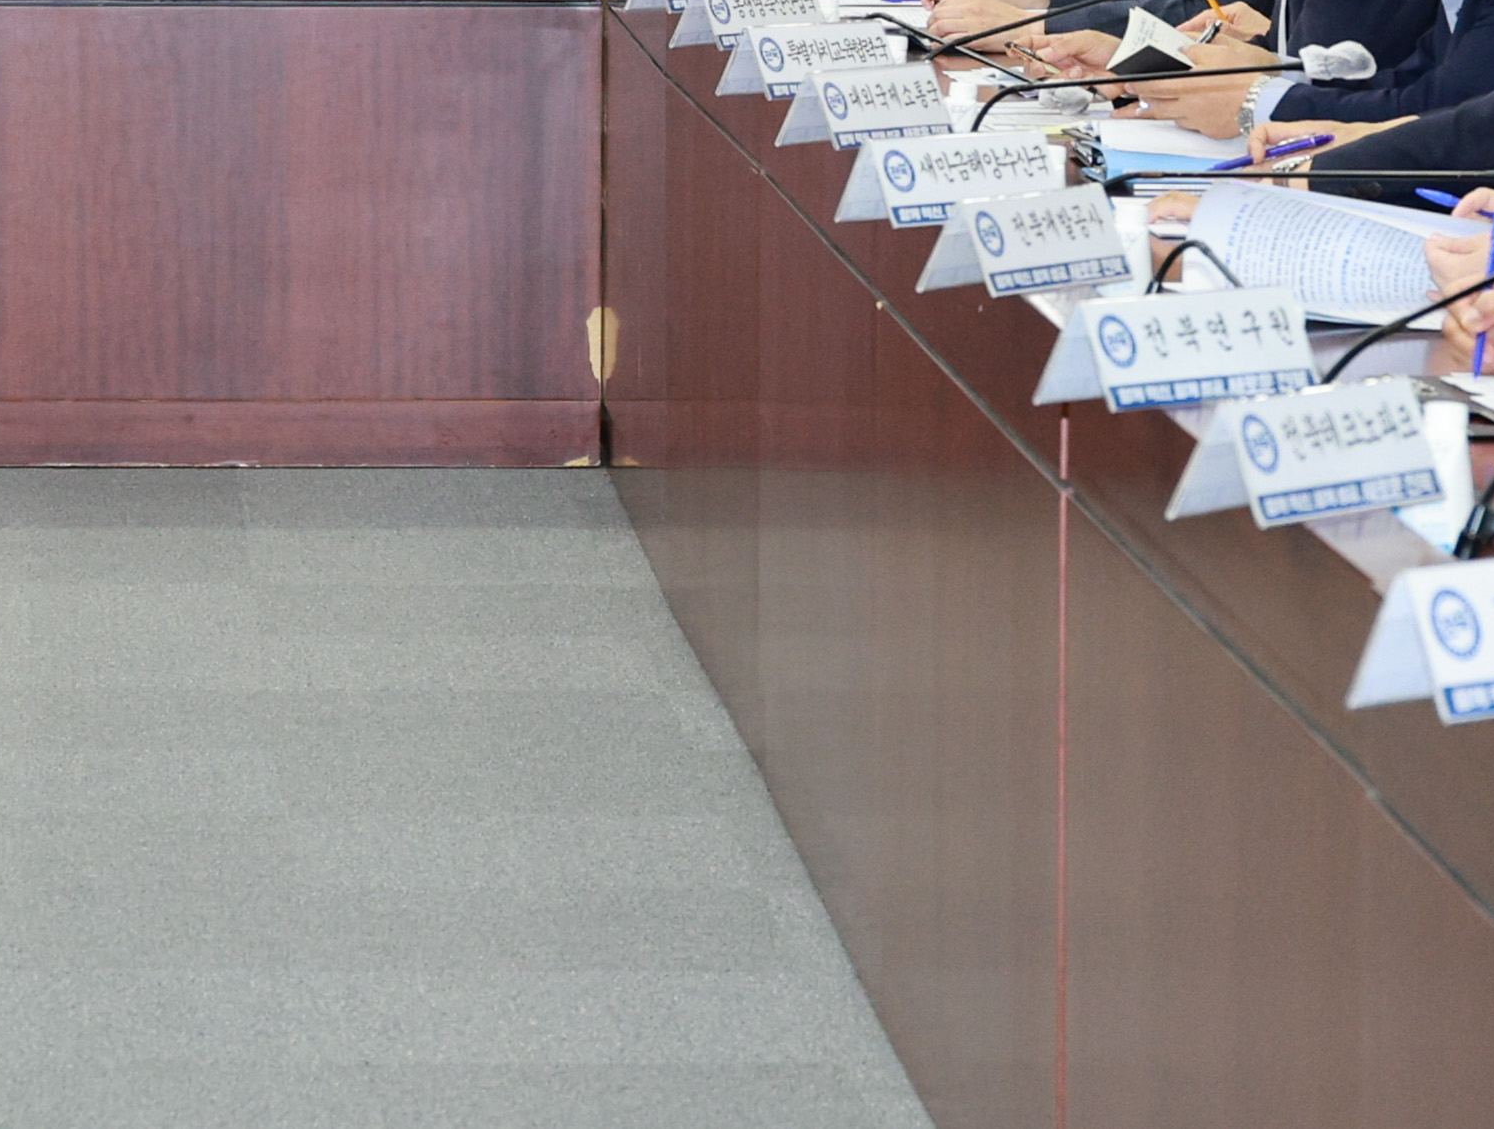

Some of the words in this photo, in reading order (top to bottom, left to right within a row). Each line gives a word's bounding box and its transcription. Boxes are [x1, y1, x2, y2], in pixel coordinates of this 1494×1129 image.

[785, 36, 890, 66] 특별자치교육협력국
[847, 79, 941, 110] 대외국제소통국
[919, 145, 1050, 184] 새만금해양수산국
[1011, 202, 1106, 248] 전북개발공사
[1143, 305, 1295, 358] 전북연구원
